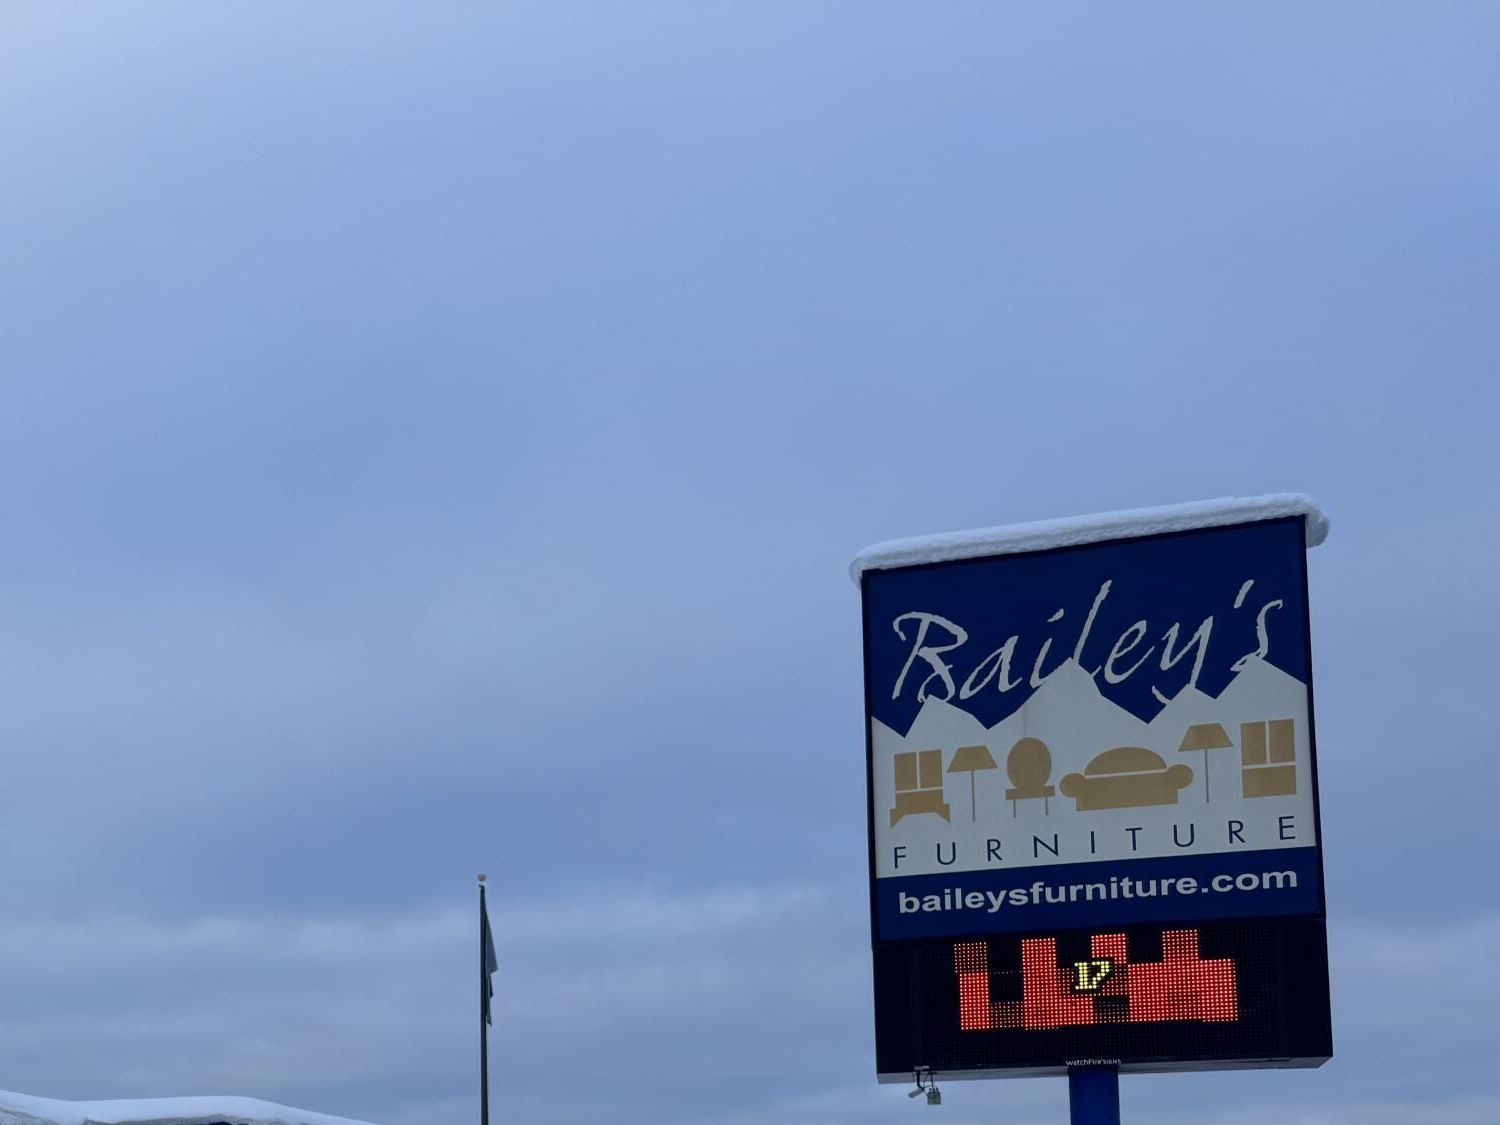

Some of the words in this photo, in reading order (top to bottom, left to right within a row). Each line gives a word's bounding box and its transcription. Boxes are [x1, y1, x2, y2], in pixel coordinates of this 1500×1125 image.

[891, 579, 1284, 705] Bailey's
[893, 815, 1297, 869] FURNITURE
[899, 870, 1298, 914] baileysfurniture.com
[1074, 961, 1110, 990] 17
